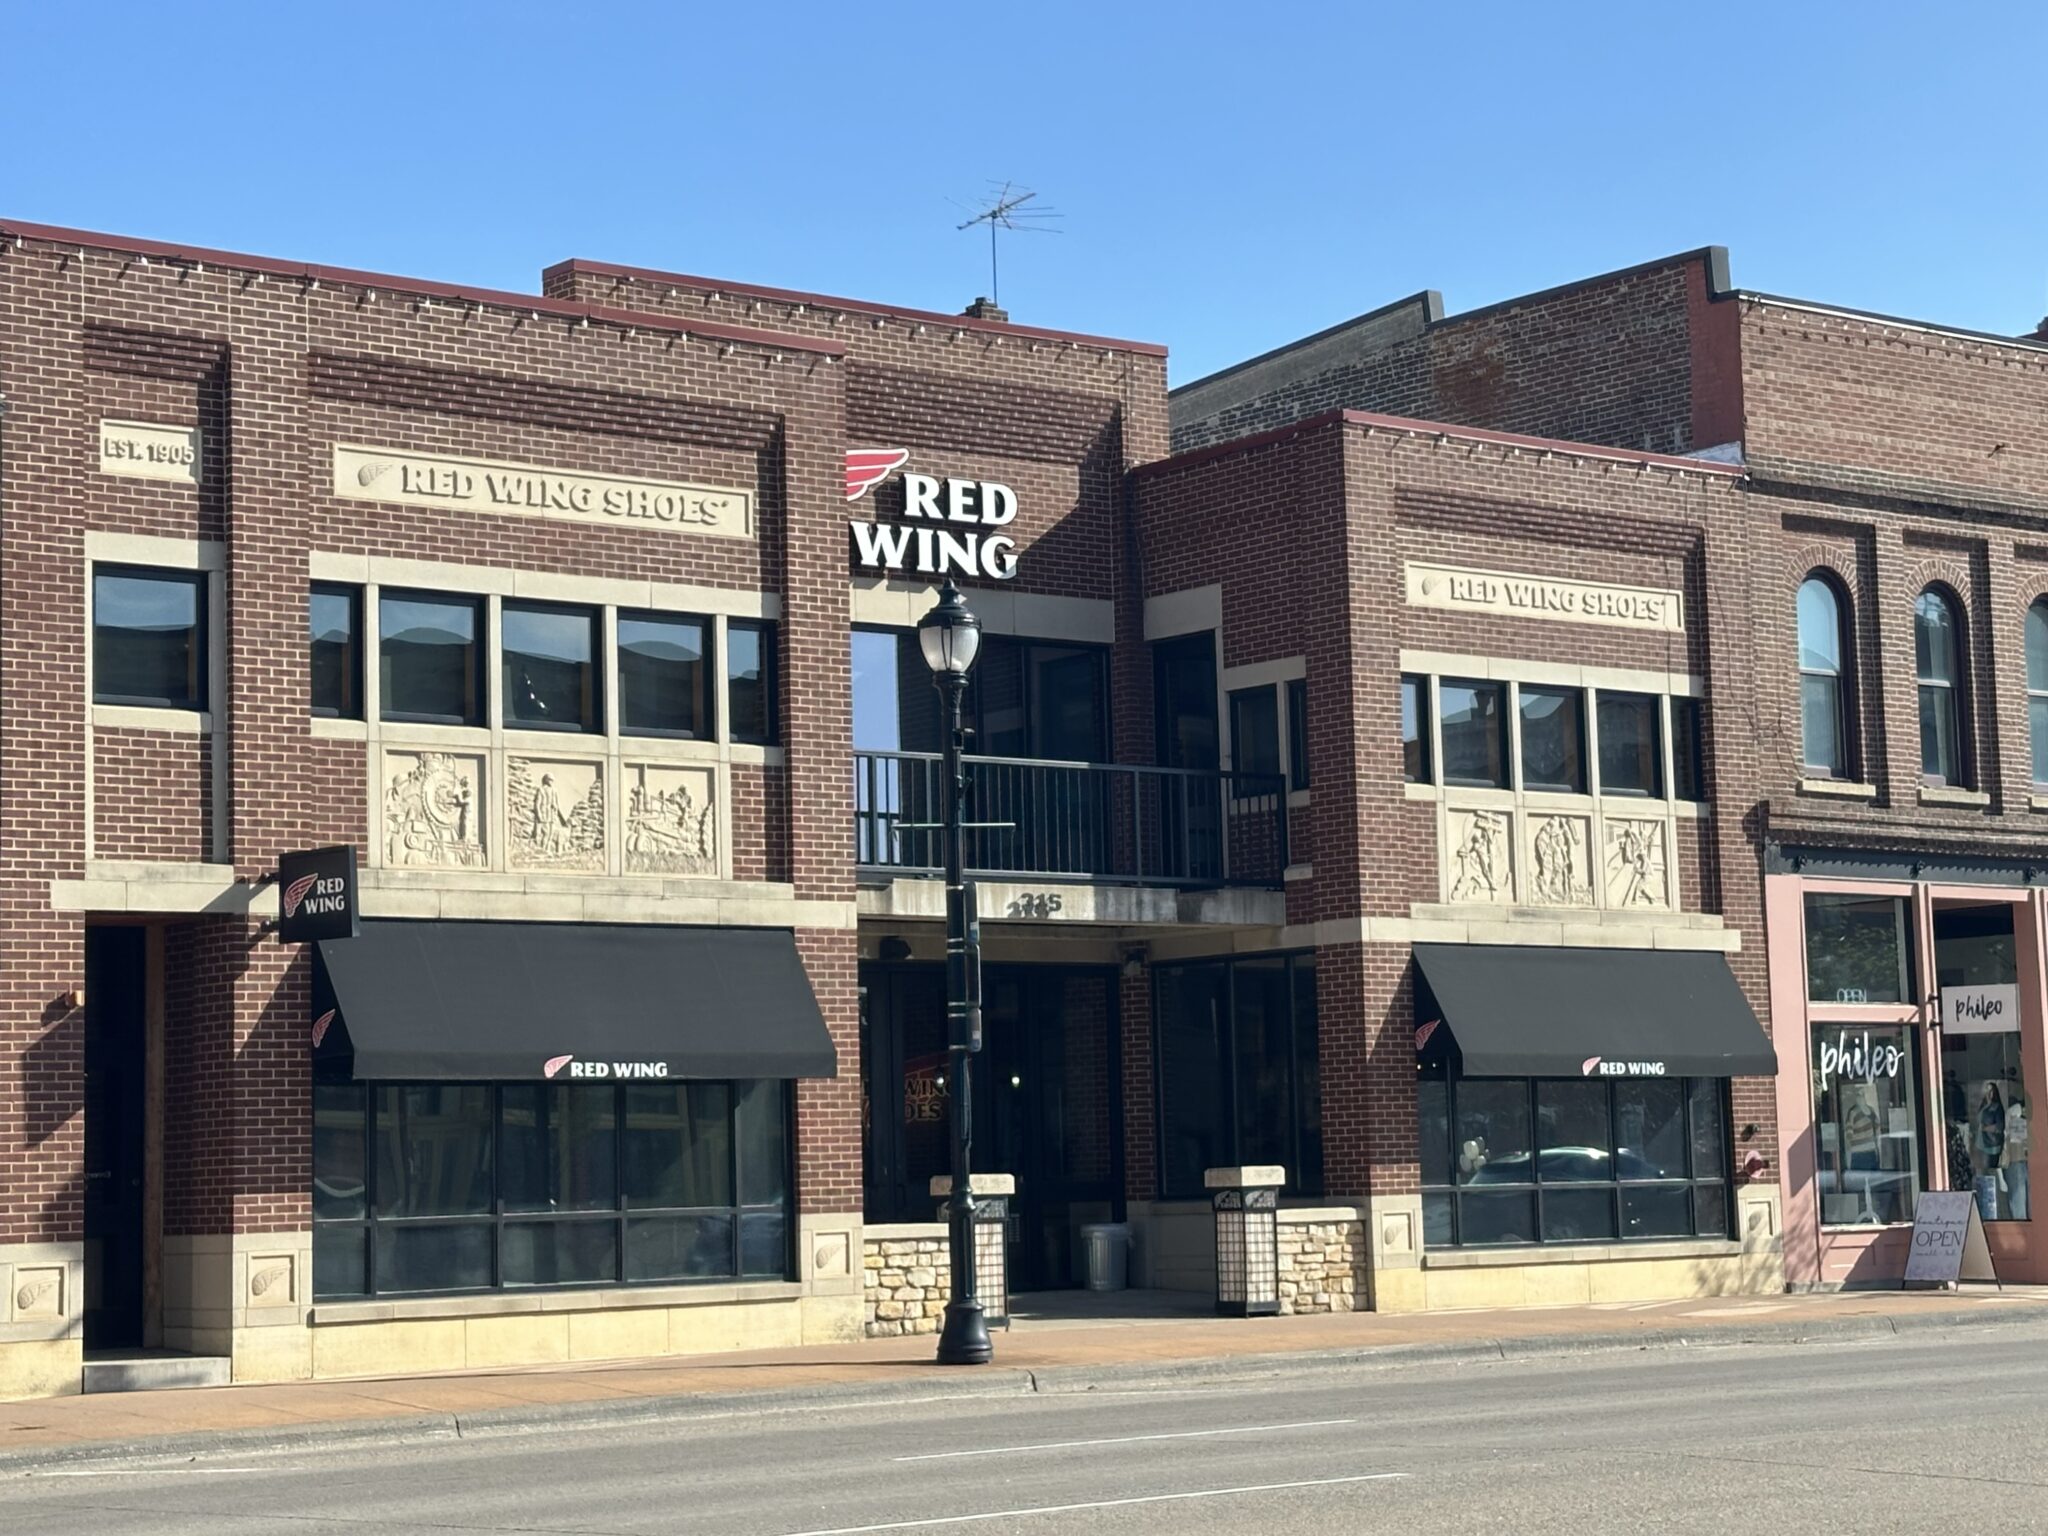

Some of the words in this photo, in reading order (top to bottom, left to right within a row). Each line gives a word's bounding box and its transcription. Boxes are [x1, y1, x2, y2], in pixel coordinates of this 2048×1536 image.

[147, 443, 195, 465] 1905
[402, 464, 480, 499] RED
[486, 473, 593, 513] WING
[903, 473, 1018, 526] RED
[850, 521, 1018, 579] WING
[1450, 577, 1497, 603] RED
[1504, 582, 1575, 613] WING
[317, 877, 345, 895] RED
[305, 895, 345, 914] WING
[1837, 988, 1867, 1003] OPEN
[1956, 994, 2003, 1022] phileo
[571, 1062, 609, 1077] RED
[613, 1062, 668, 1078] WING
[1600, 1062, 1626, 1075] RED
[1628, 1062, 1665, 1075] WING
[1821, 1030, 1904, 1091] phileo
[1916, 1231, 1963, 1247] OPEN
